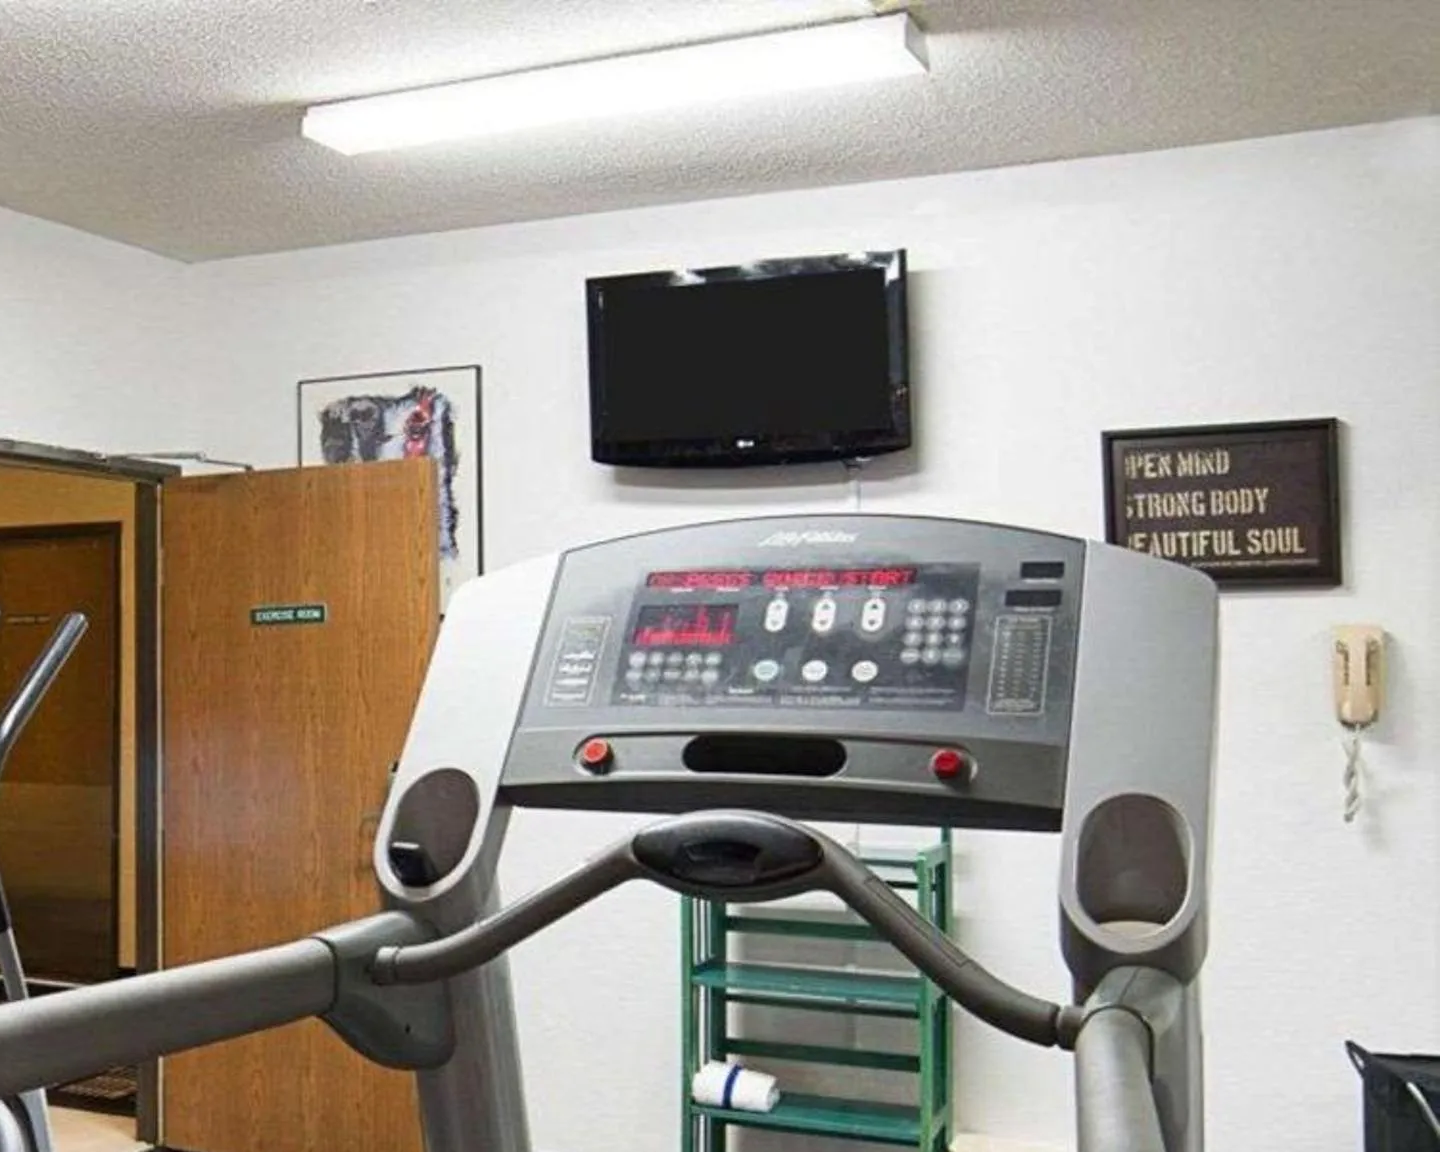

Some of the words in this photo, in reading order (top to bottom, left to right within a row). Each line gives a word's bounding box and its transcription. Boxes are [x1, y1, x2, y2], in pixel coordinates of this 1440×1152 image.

[1177, 449, 1230, 477] MIND
[1211, 488, 1269, 516] BODY
[1128, 530, 1241, 558] EAUTIFUL
[1247, 527, 1306, 555] SOUL
